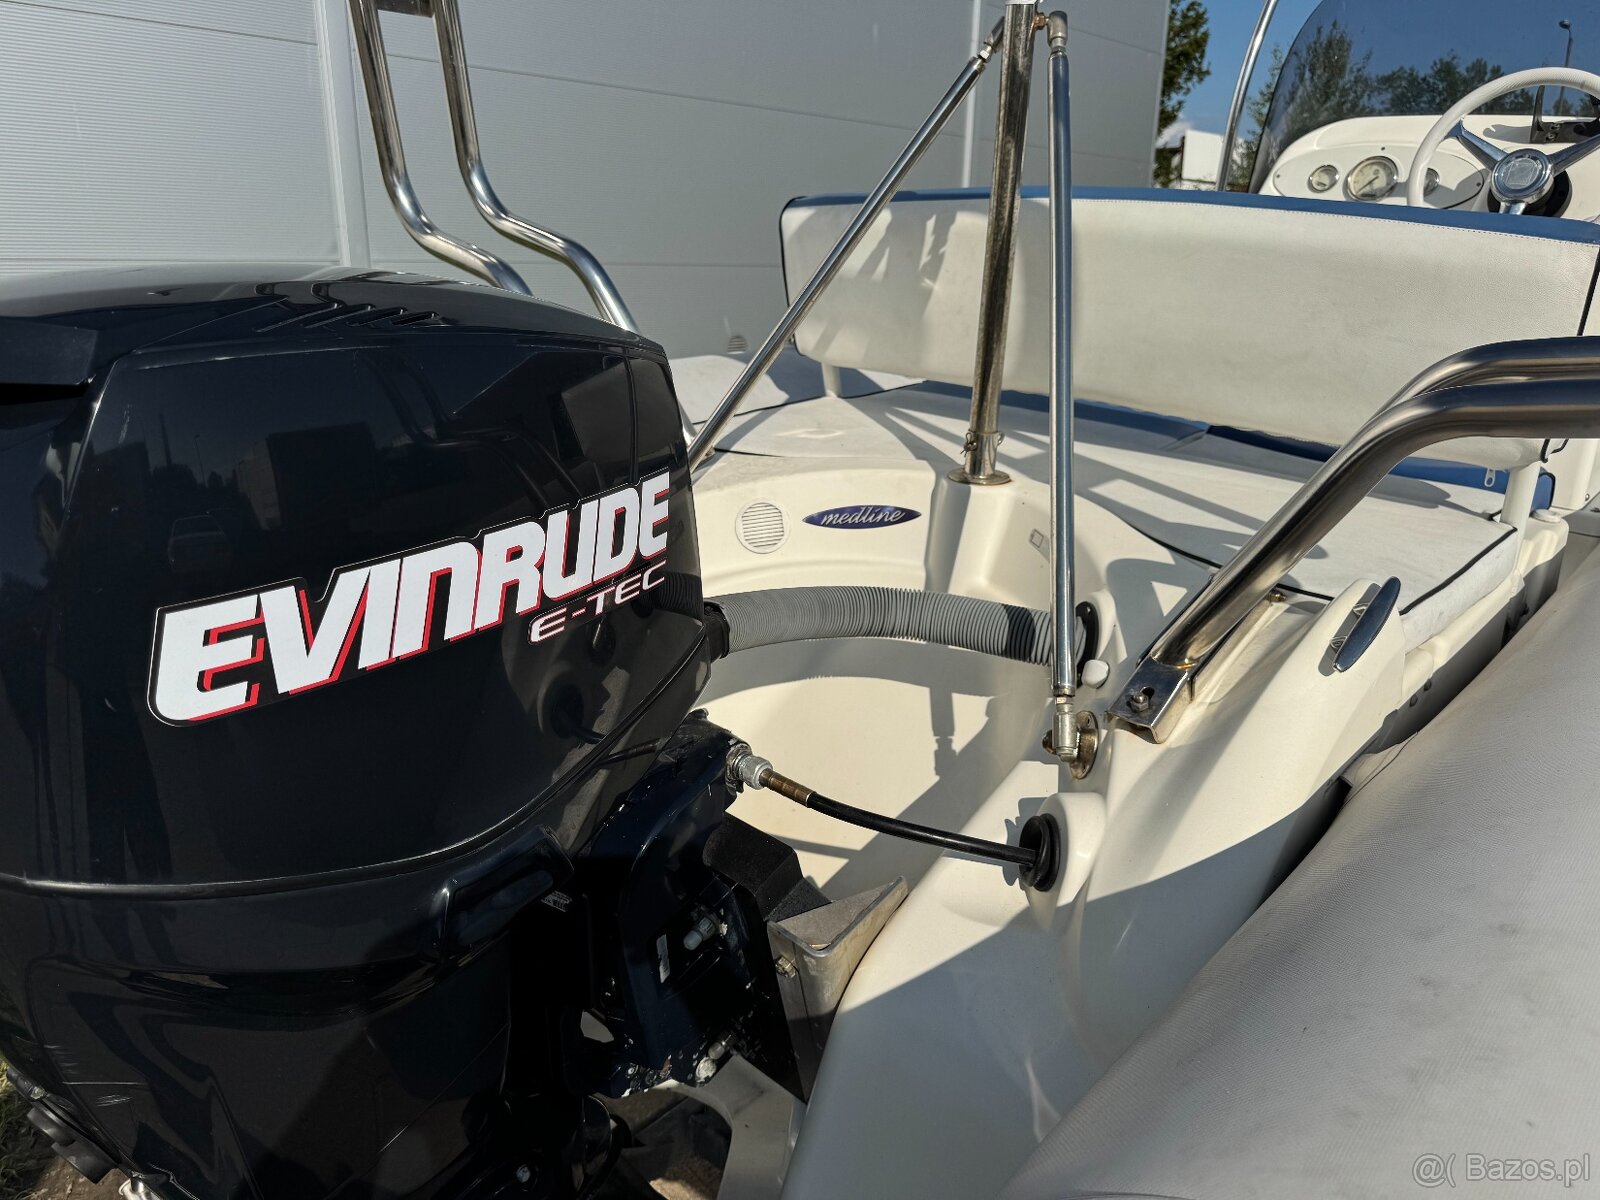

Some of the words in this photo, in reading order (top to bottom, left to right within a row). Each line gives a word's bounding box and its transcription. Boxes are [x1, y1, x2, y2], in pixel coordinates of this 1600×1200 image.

[821, 506, 905, 525] medline
[154, 470, 670, 722] EVINRUDE
[530, 558, 667, 643] E-TEC
